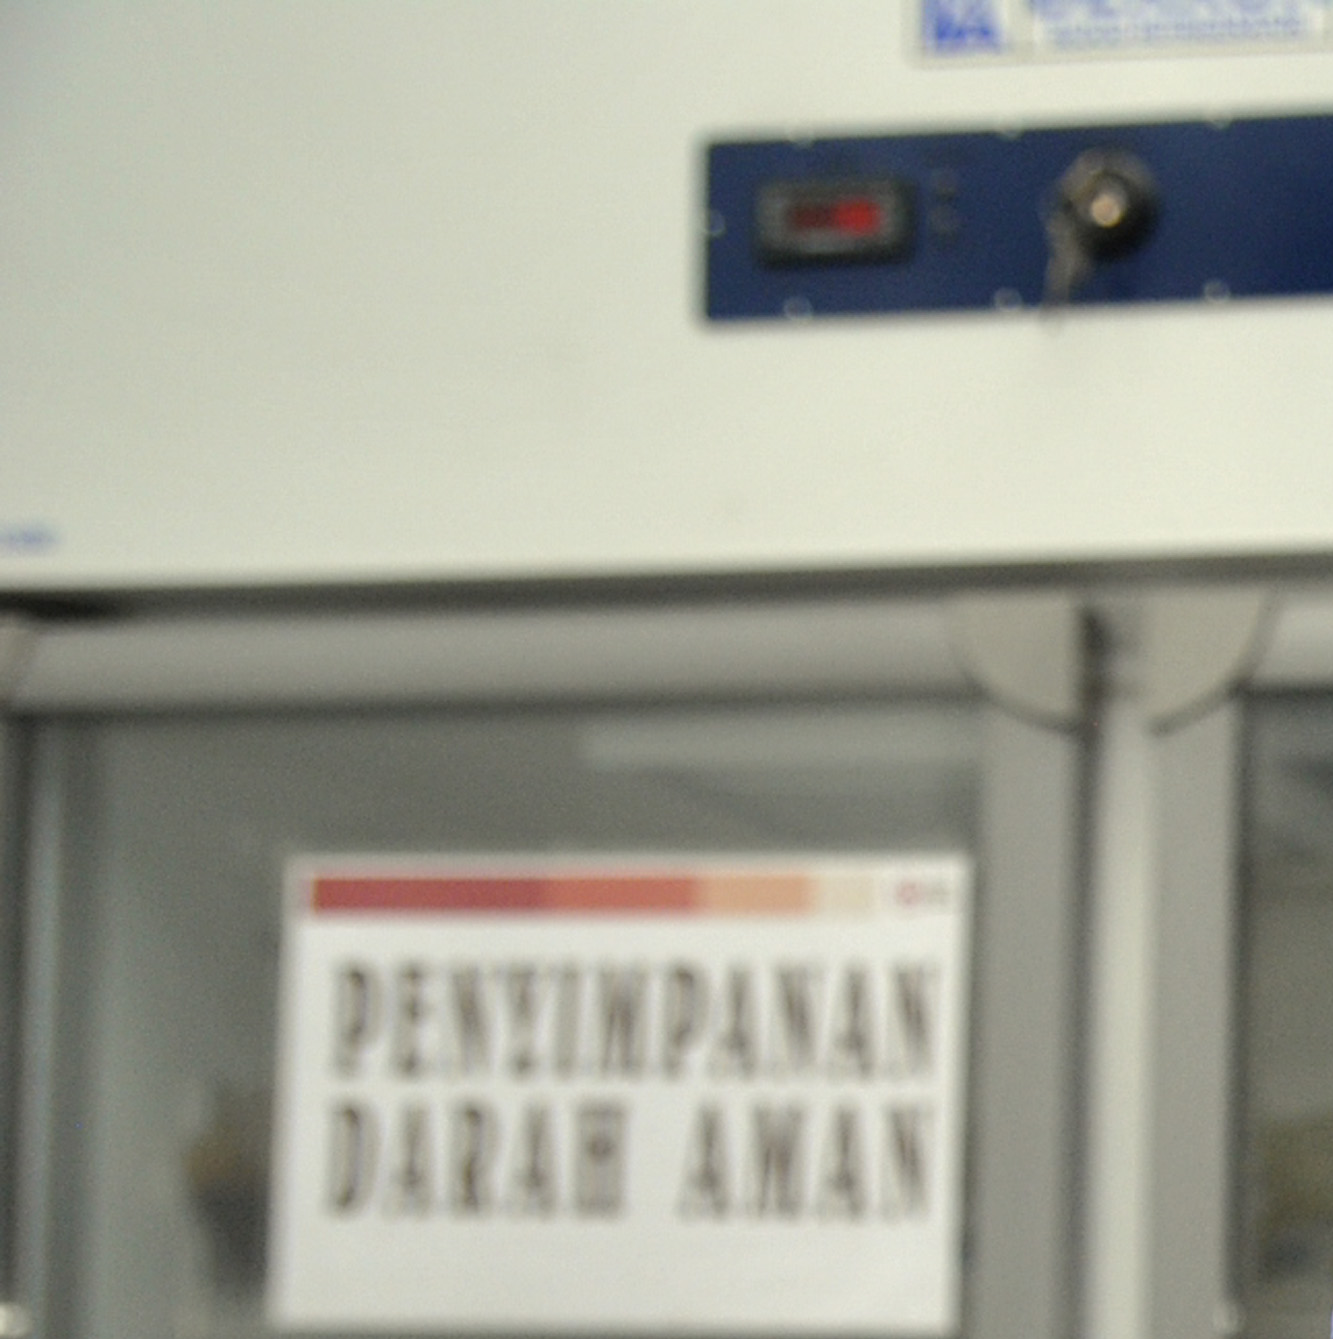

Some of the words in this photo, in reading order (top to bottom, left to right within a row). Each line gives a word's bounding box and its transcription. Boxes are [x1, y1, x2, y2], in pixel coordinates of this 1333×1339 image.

[328, 960, 944, 1082] PENYIMPANAN
[322, 1097, 630, 1222] DARAH
[680, 1100, 938, 1224] AMAN
